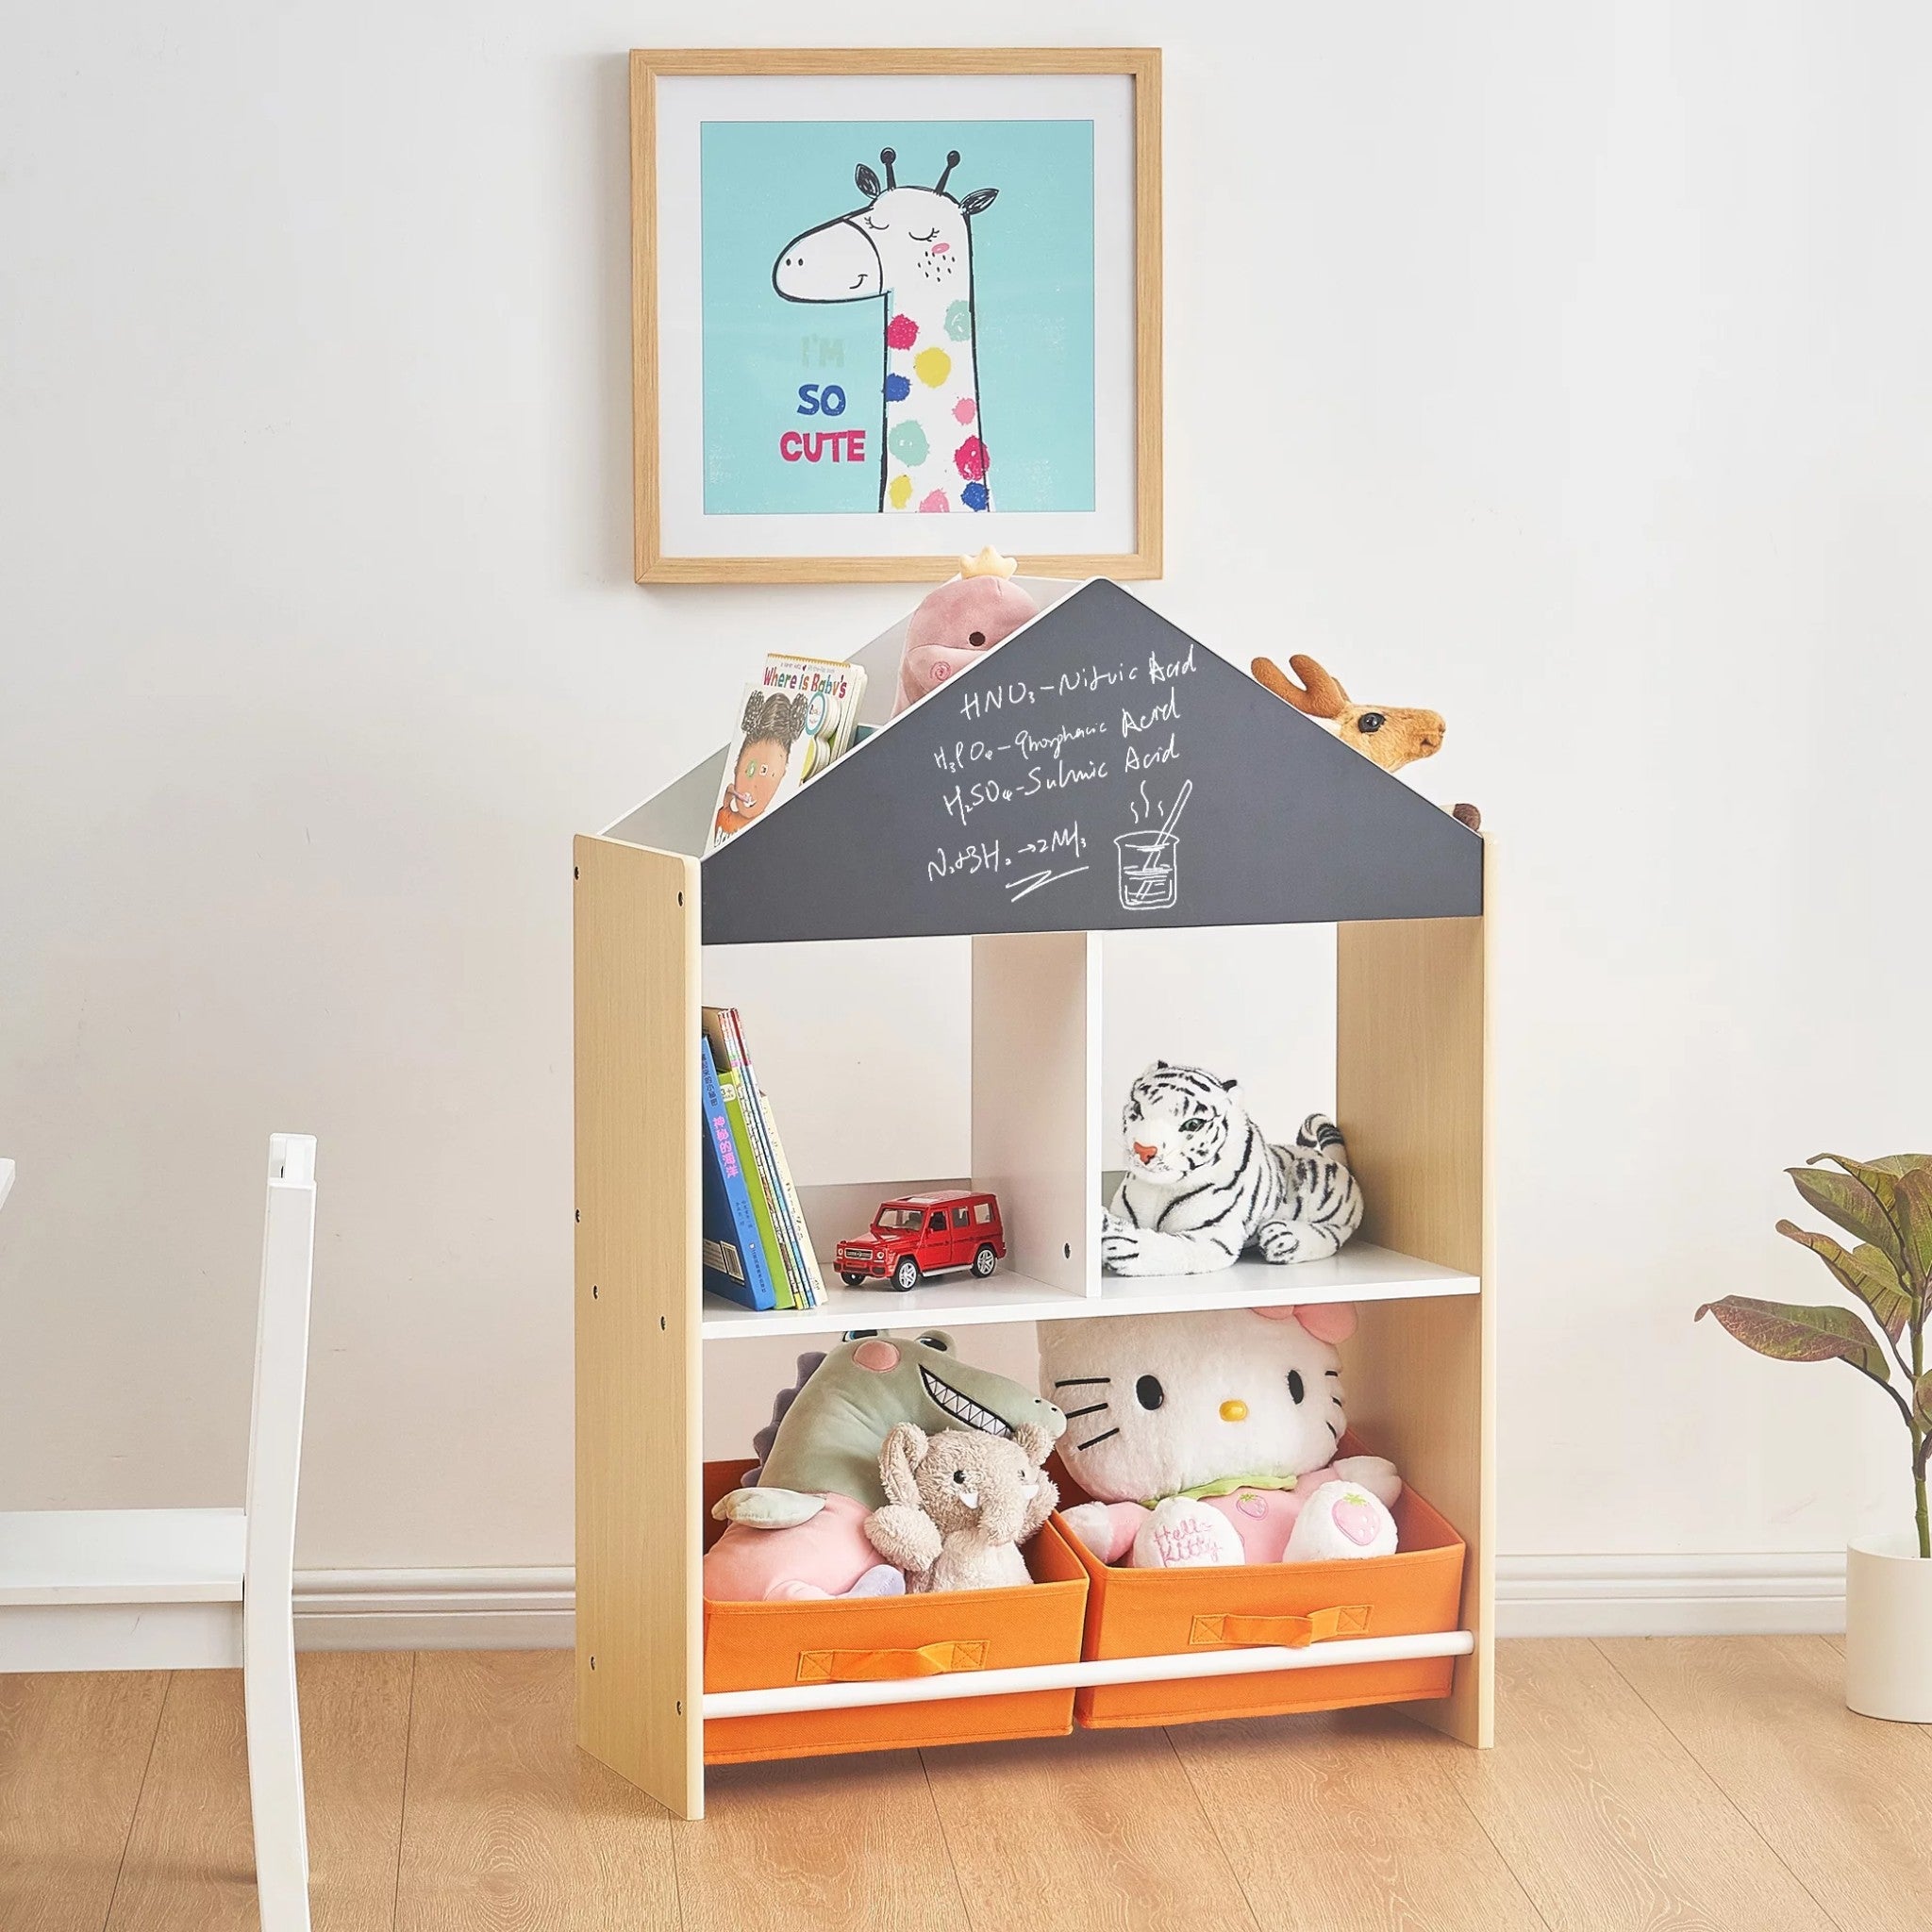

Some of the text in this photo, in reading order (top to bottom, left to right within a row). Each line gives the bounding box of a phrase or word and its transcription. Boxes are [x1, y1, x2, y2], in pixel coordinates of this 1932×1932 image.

[801, 334, 844, 368] I'M
[796, 383, 846, 416] SO
[780, 429, 866, 462] CUTE
[1149, 643, 1197, 685] Acid
[763, 666, 797, 690] Where
[810, 673, 847, 699] Baby's
[1124, 733, 1180, 773] Acid
